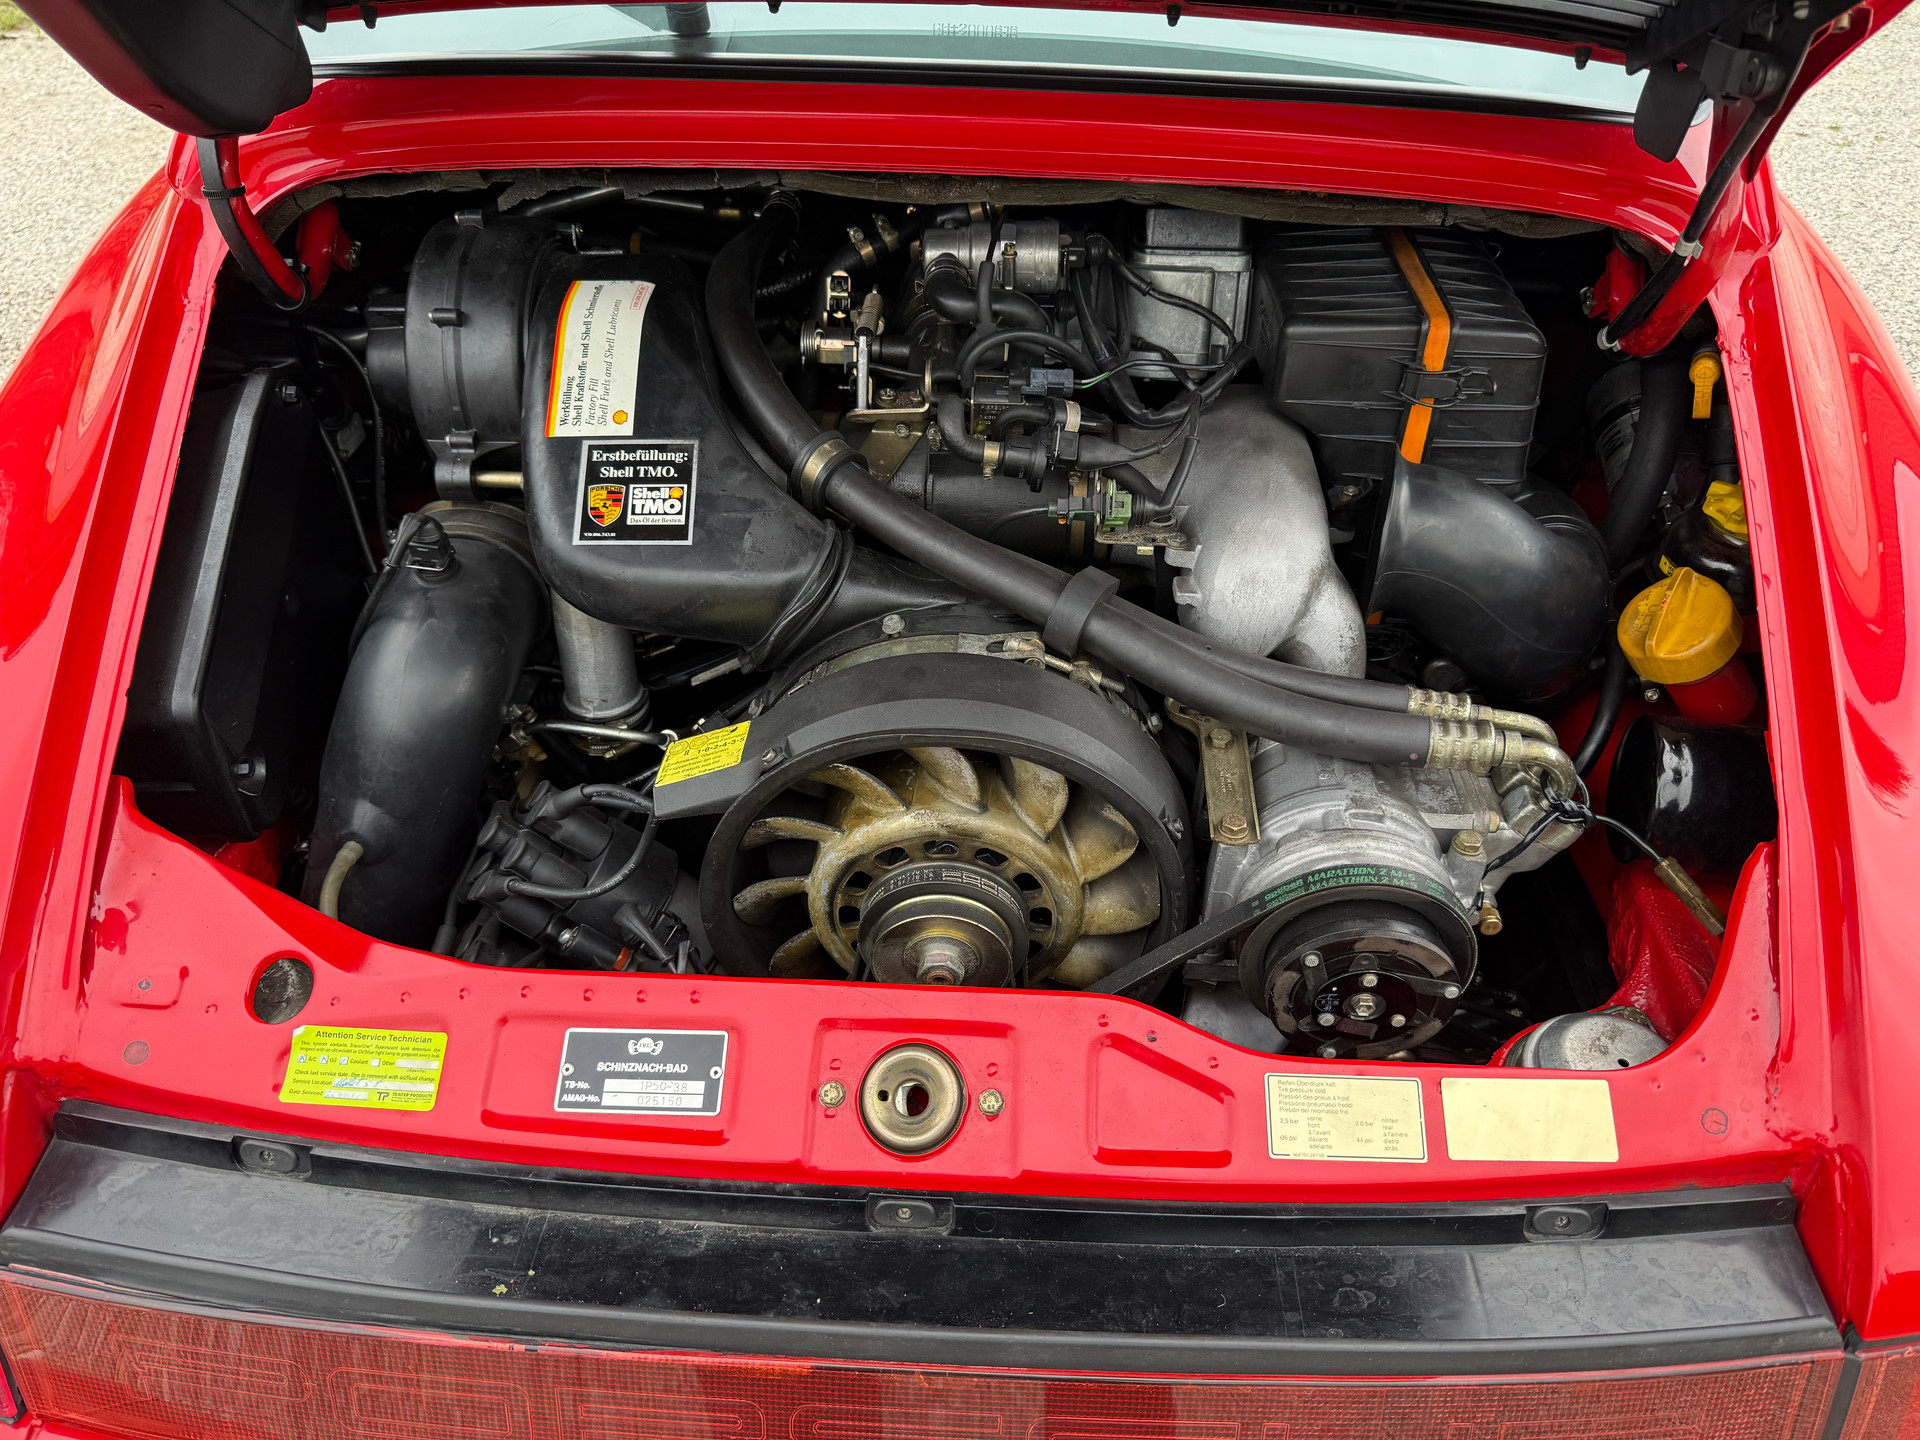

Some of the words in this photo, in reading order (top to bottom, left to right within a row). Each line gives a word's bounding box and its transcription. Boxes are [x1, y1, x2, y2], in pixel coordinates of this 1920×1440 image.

[609, 299, 622, 336] Lubricants
[581, 321, 592, 341] Shell
[604, 337, 616, 359] Shell
[604, 360, 612, 377] and
[576, 360, 587, 402] Kraftstoffe
[589, 378, 599, 392] Fill
[600, 379, 611, 402] Fuels
[560, 376, 576, 426] Werkfüllung
[572, 404, 582, 426] Shell
[585, 394, 599, 426] Factory
[598, 404, 609, 426] Shell
[592, 450, 688, 464] Erstbefüllung:
[600, 466, 634, 478] Shell
[637, 466, 678, 478] TMO.
[633, 488, 670, 499] Shell
[633, 499, 682, 514] TMO
[1308, 867, 1376, 883] MARATHON
[315, 1031, 353, 1039] Attention
[356, 1033, 386, 1042] Service
[389, 1034, 432, 1043] Technician
[596, 1062, 688, 1073] SCHINZNACH-BAD
[561, 1094, 600, 1103] AMAG-No.
[637, 1096, 682, 1106] 025150
